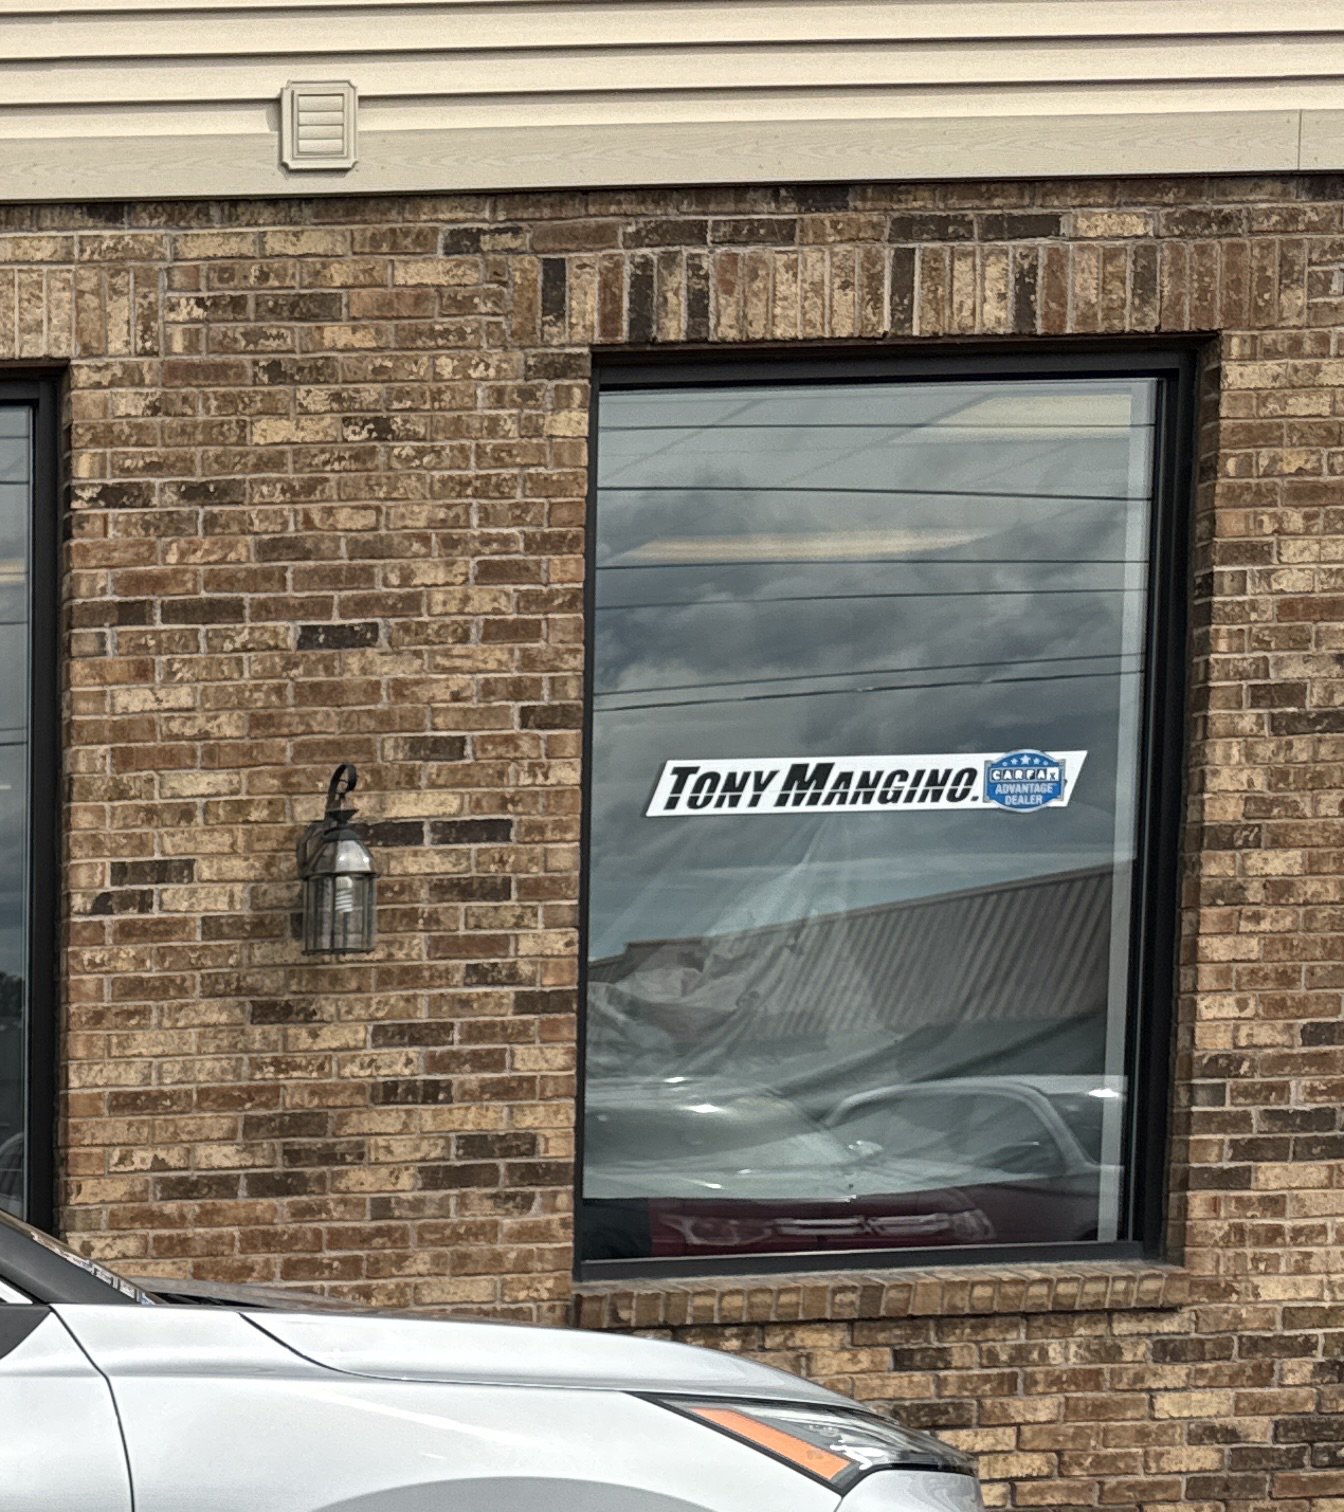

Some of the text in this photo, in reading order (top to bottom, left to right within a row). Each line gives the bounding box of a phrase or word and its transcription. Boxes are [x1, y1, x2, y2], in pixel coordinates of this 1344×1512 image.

[990, 767, 1059, 782] CARFAX
[663, 765, 780, 811] TONY
[995, 782, 1053, 794] ADVANTAGE
[1004, 794, 1043, 806] DEALER
